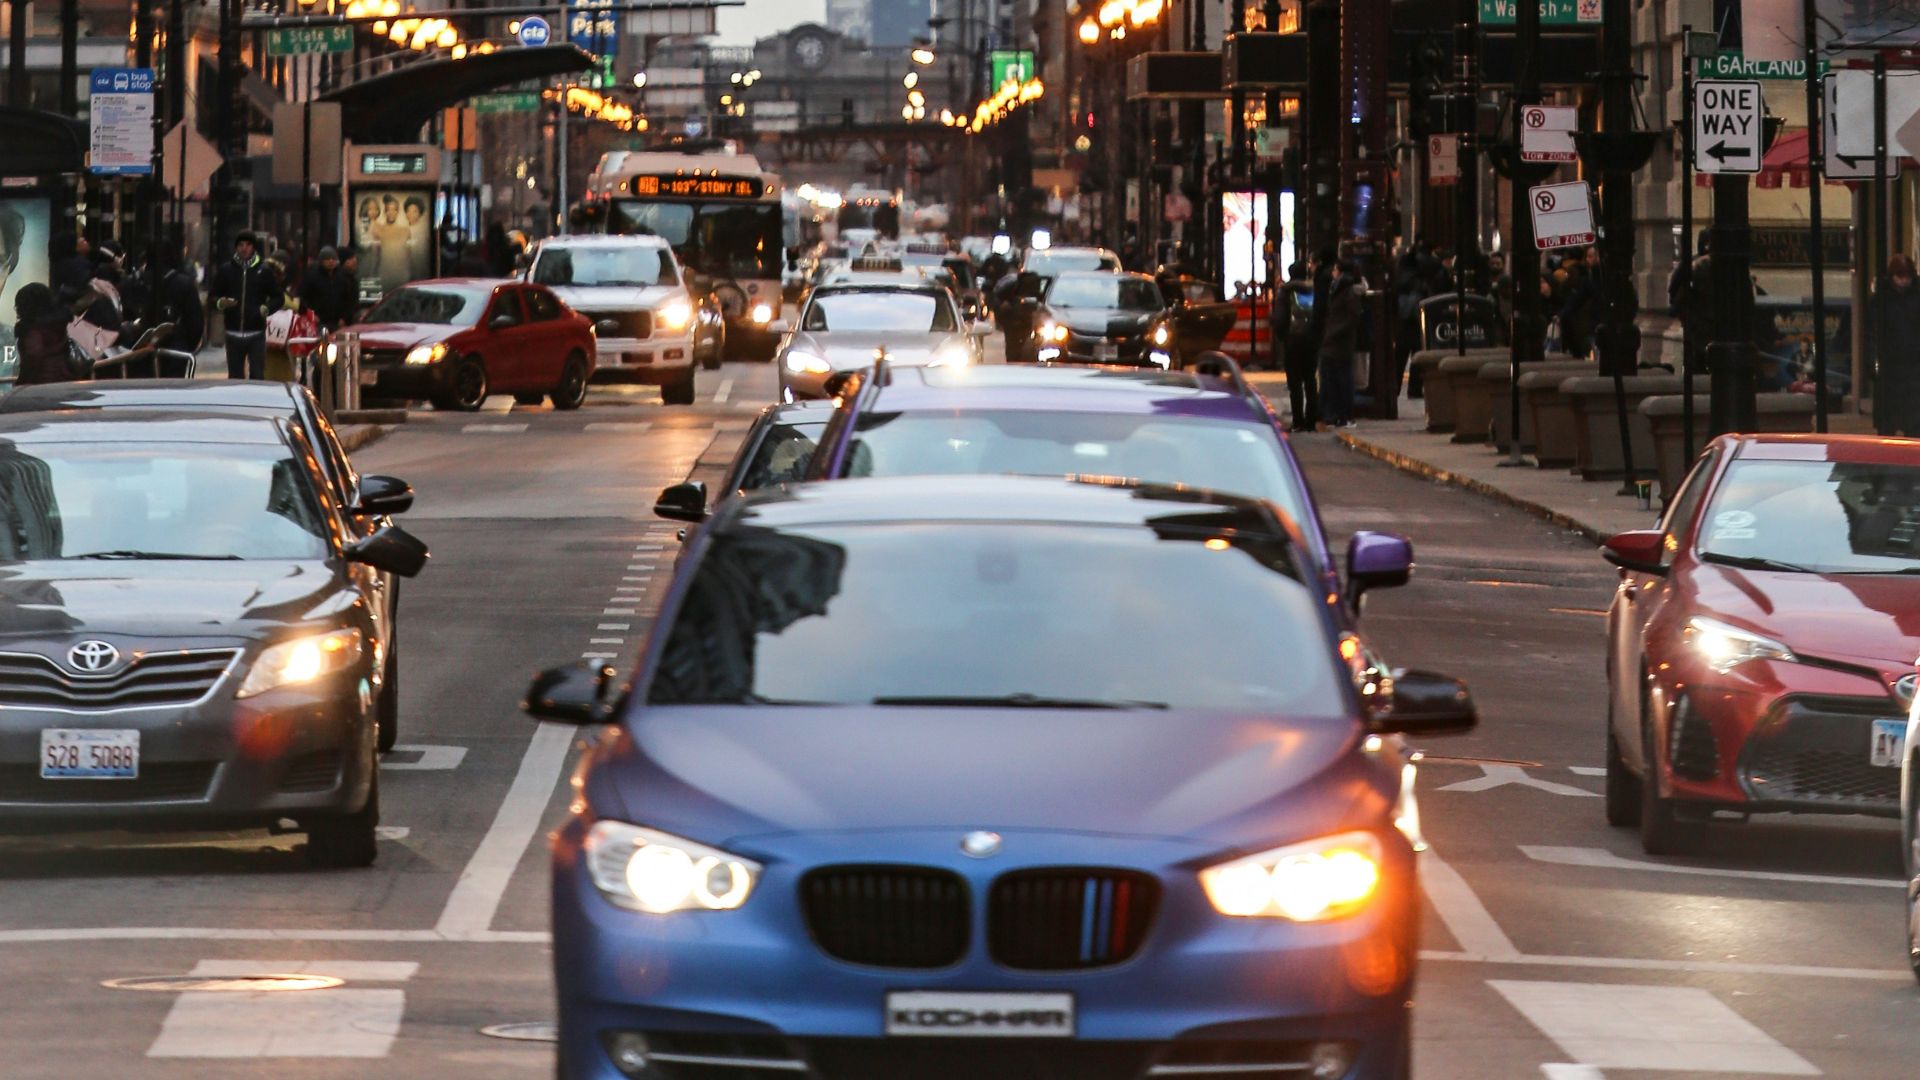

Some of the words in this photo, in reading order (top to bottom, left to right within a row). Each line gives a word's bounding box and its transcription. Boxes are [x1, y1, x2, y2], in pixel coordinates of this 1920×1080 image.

[1484, 3, 1491, 12] N
[1496, 0, 1557, 17] Wash
[272, 32, 281, 44] N
[289, 30, 324, 43] State
[333, 26, 347, 41] St
[524, 25, 546, 38] cta
[1703, 58, 1712, 70] N
[1716, 55, 1806, 76] GARLAND
[131, 72, 148, 81] bus
[131, 80, 151, 91] stop
[1703, 89, 1752, 110] ONE
[1702, 114, 1752, 136] WAY
[1526, 152, 1544, 160] TOW
[1549, 152, 1572, 160] ZONE
[1543, 237, 1561, 247] TOW
[1564, 233, 1588, 245] ZONE
[3, 345, 17, 363] E
[47, 745, 79, 769] S28
[90, 745, 133, 769] 5088
